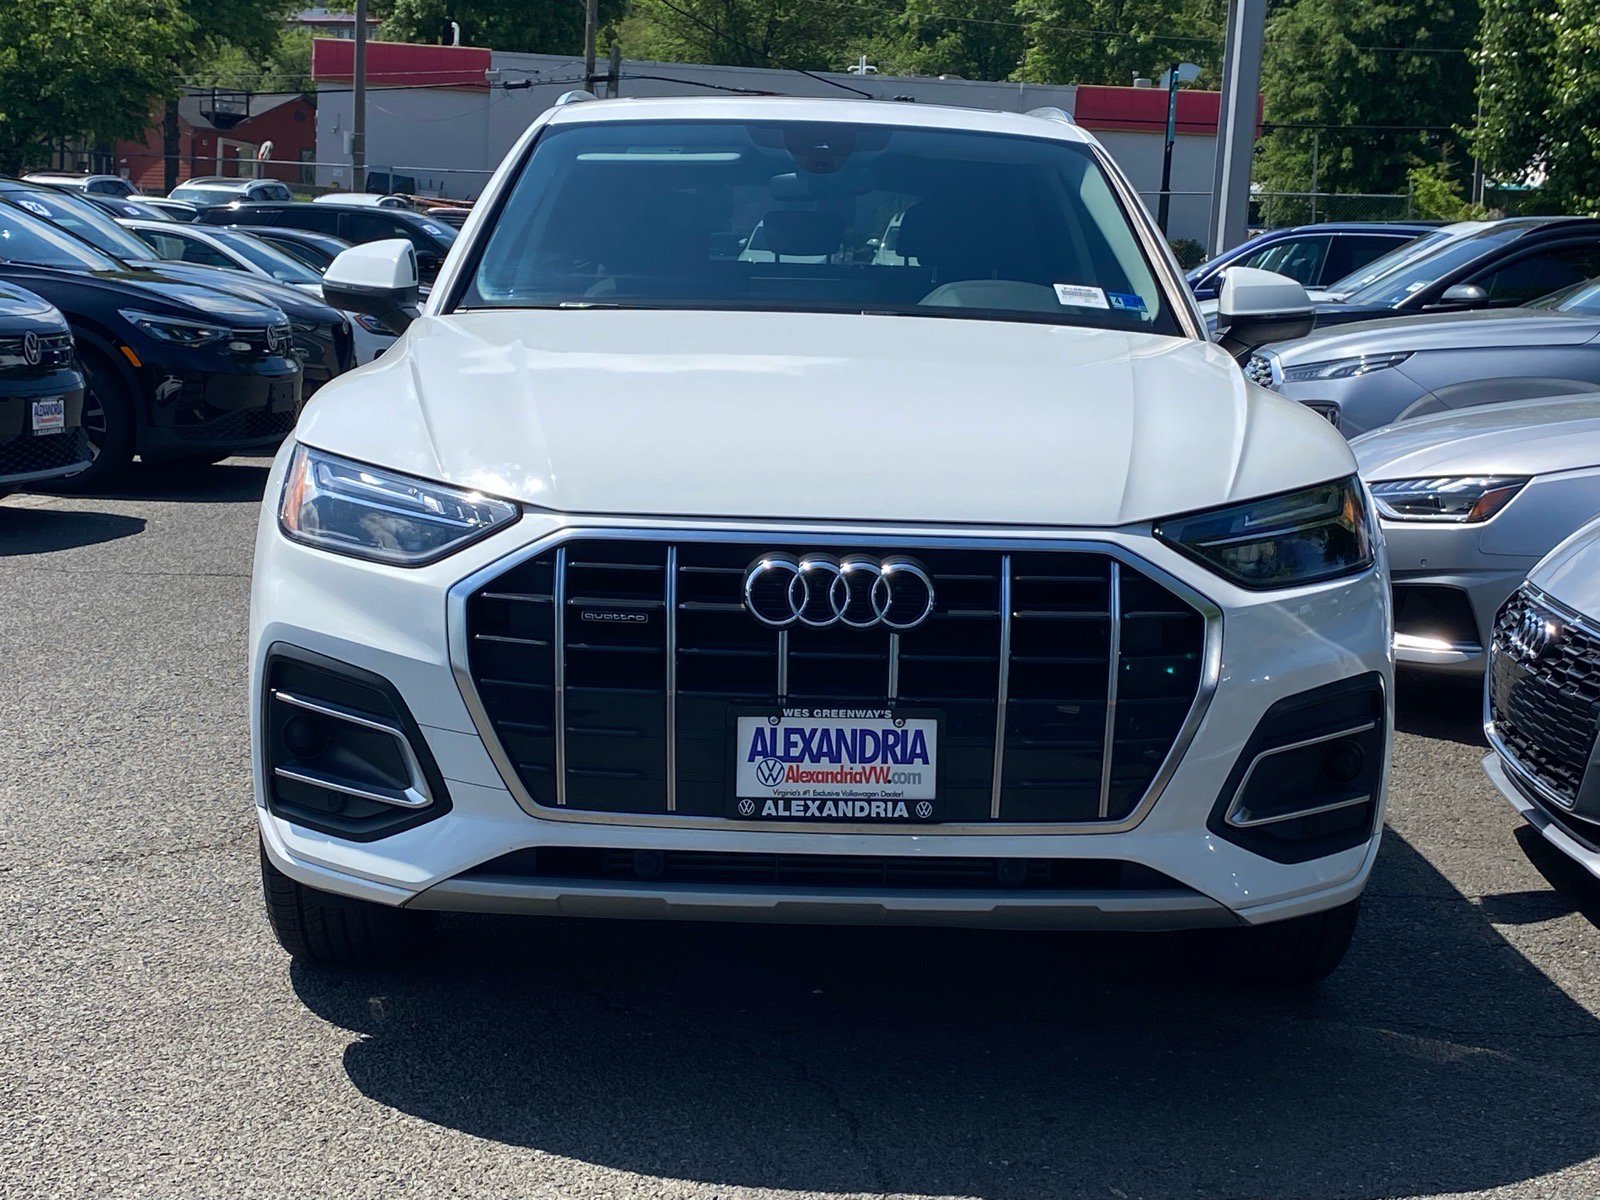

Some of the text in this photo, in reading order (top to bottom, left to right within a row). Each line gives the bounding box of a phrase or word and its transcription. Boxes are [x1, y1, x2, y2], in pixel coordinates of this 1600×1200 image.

[584, 612, 645, 621] quattro
[783, 708, 892, 719] WES GREENWAY'S
[747, 726, 930, 765] ALEXANDRIA
[785, 764, 922, 785] AlexandriaVW.com
[773, 789, 801, 798] Virginia's
[813, 789, 840, 797] Exclusive
[841, 790, 880, 798] Volkswagen
[761, 800, 909, 818] ALEXANDRIA
